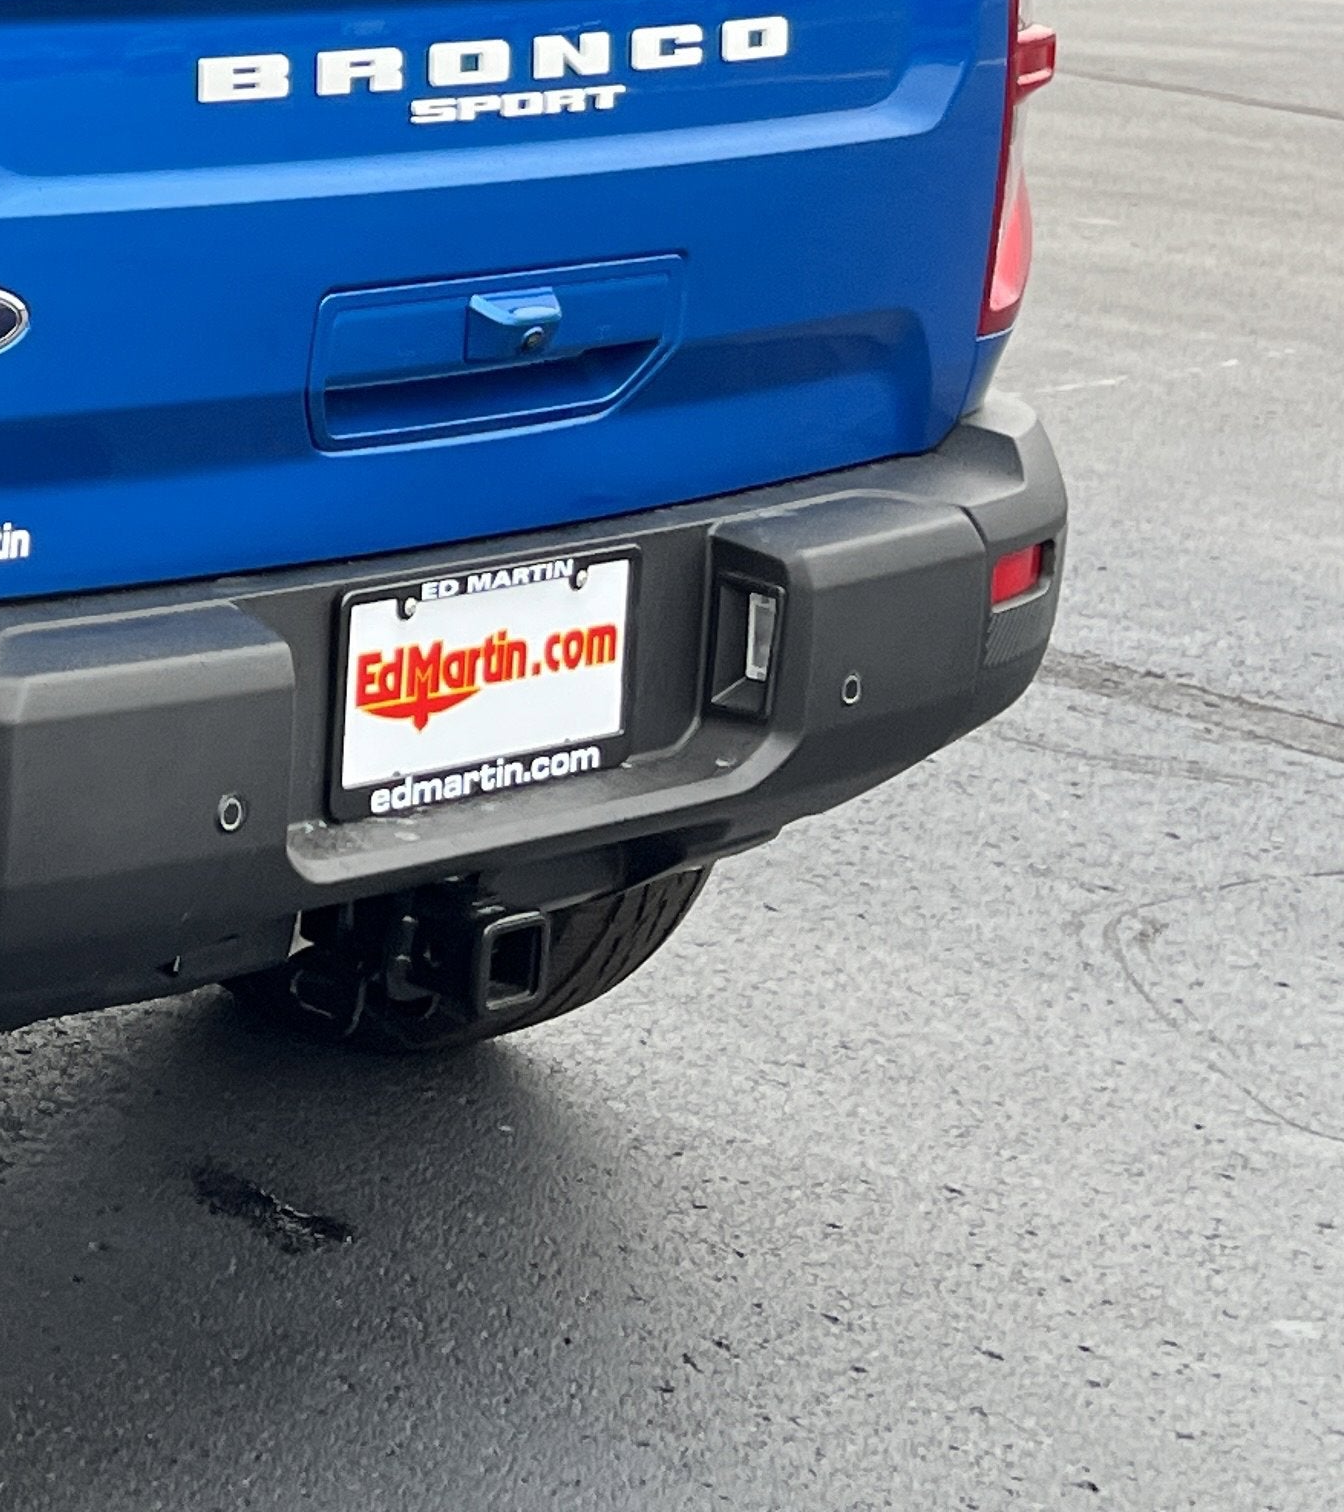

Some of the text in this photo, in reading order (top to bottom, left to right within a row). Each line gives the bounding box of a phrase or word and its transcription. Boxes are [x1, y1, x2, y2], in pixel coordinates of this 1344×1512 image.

[197, 15, 789, 104] BRONCO
[410, 84, 627, 125] SPORT
[421, 558, 574, 602] ED MARTIN
[370, 744, 601, 815] edmartin.com
